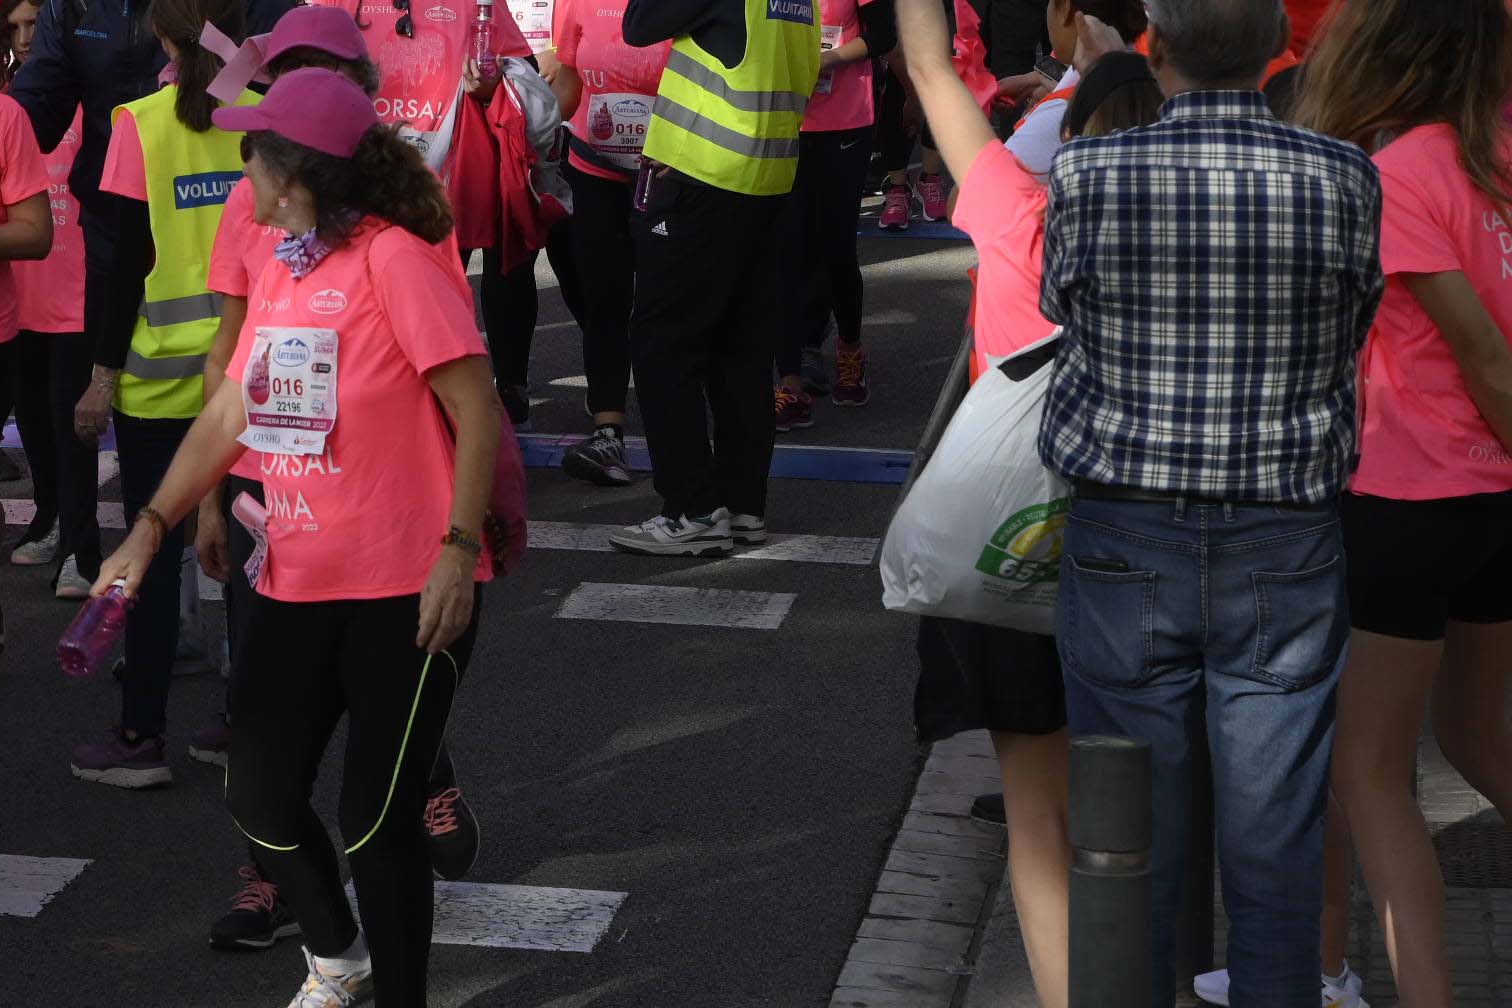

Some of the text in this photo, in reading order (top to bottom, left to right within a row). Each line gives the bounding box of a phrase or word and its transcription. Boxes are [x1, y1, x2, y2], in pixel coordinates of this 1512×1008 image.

[582, 69, 605, 89] TU
[615, 123, 646, 135] 016
[272, 378, 305, 396] 016
[276, 400, 302, 414] 22196
